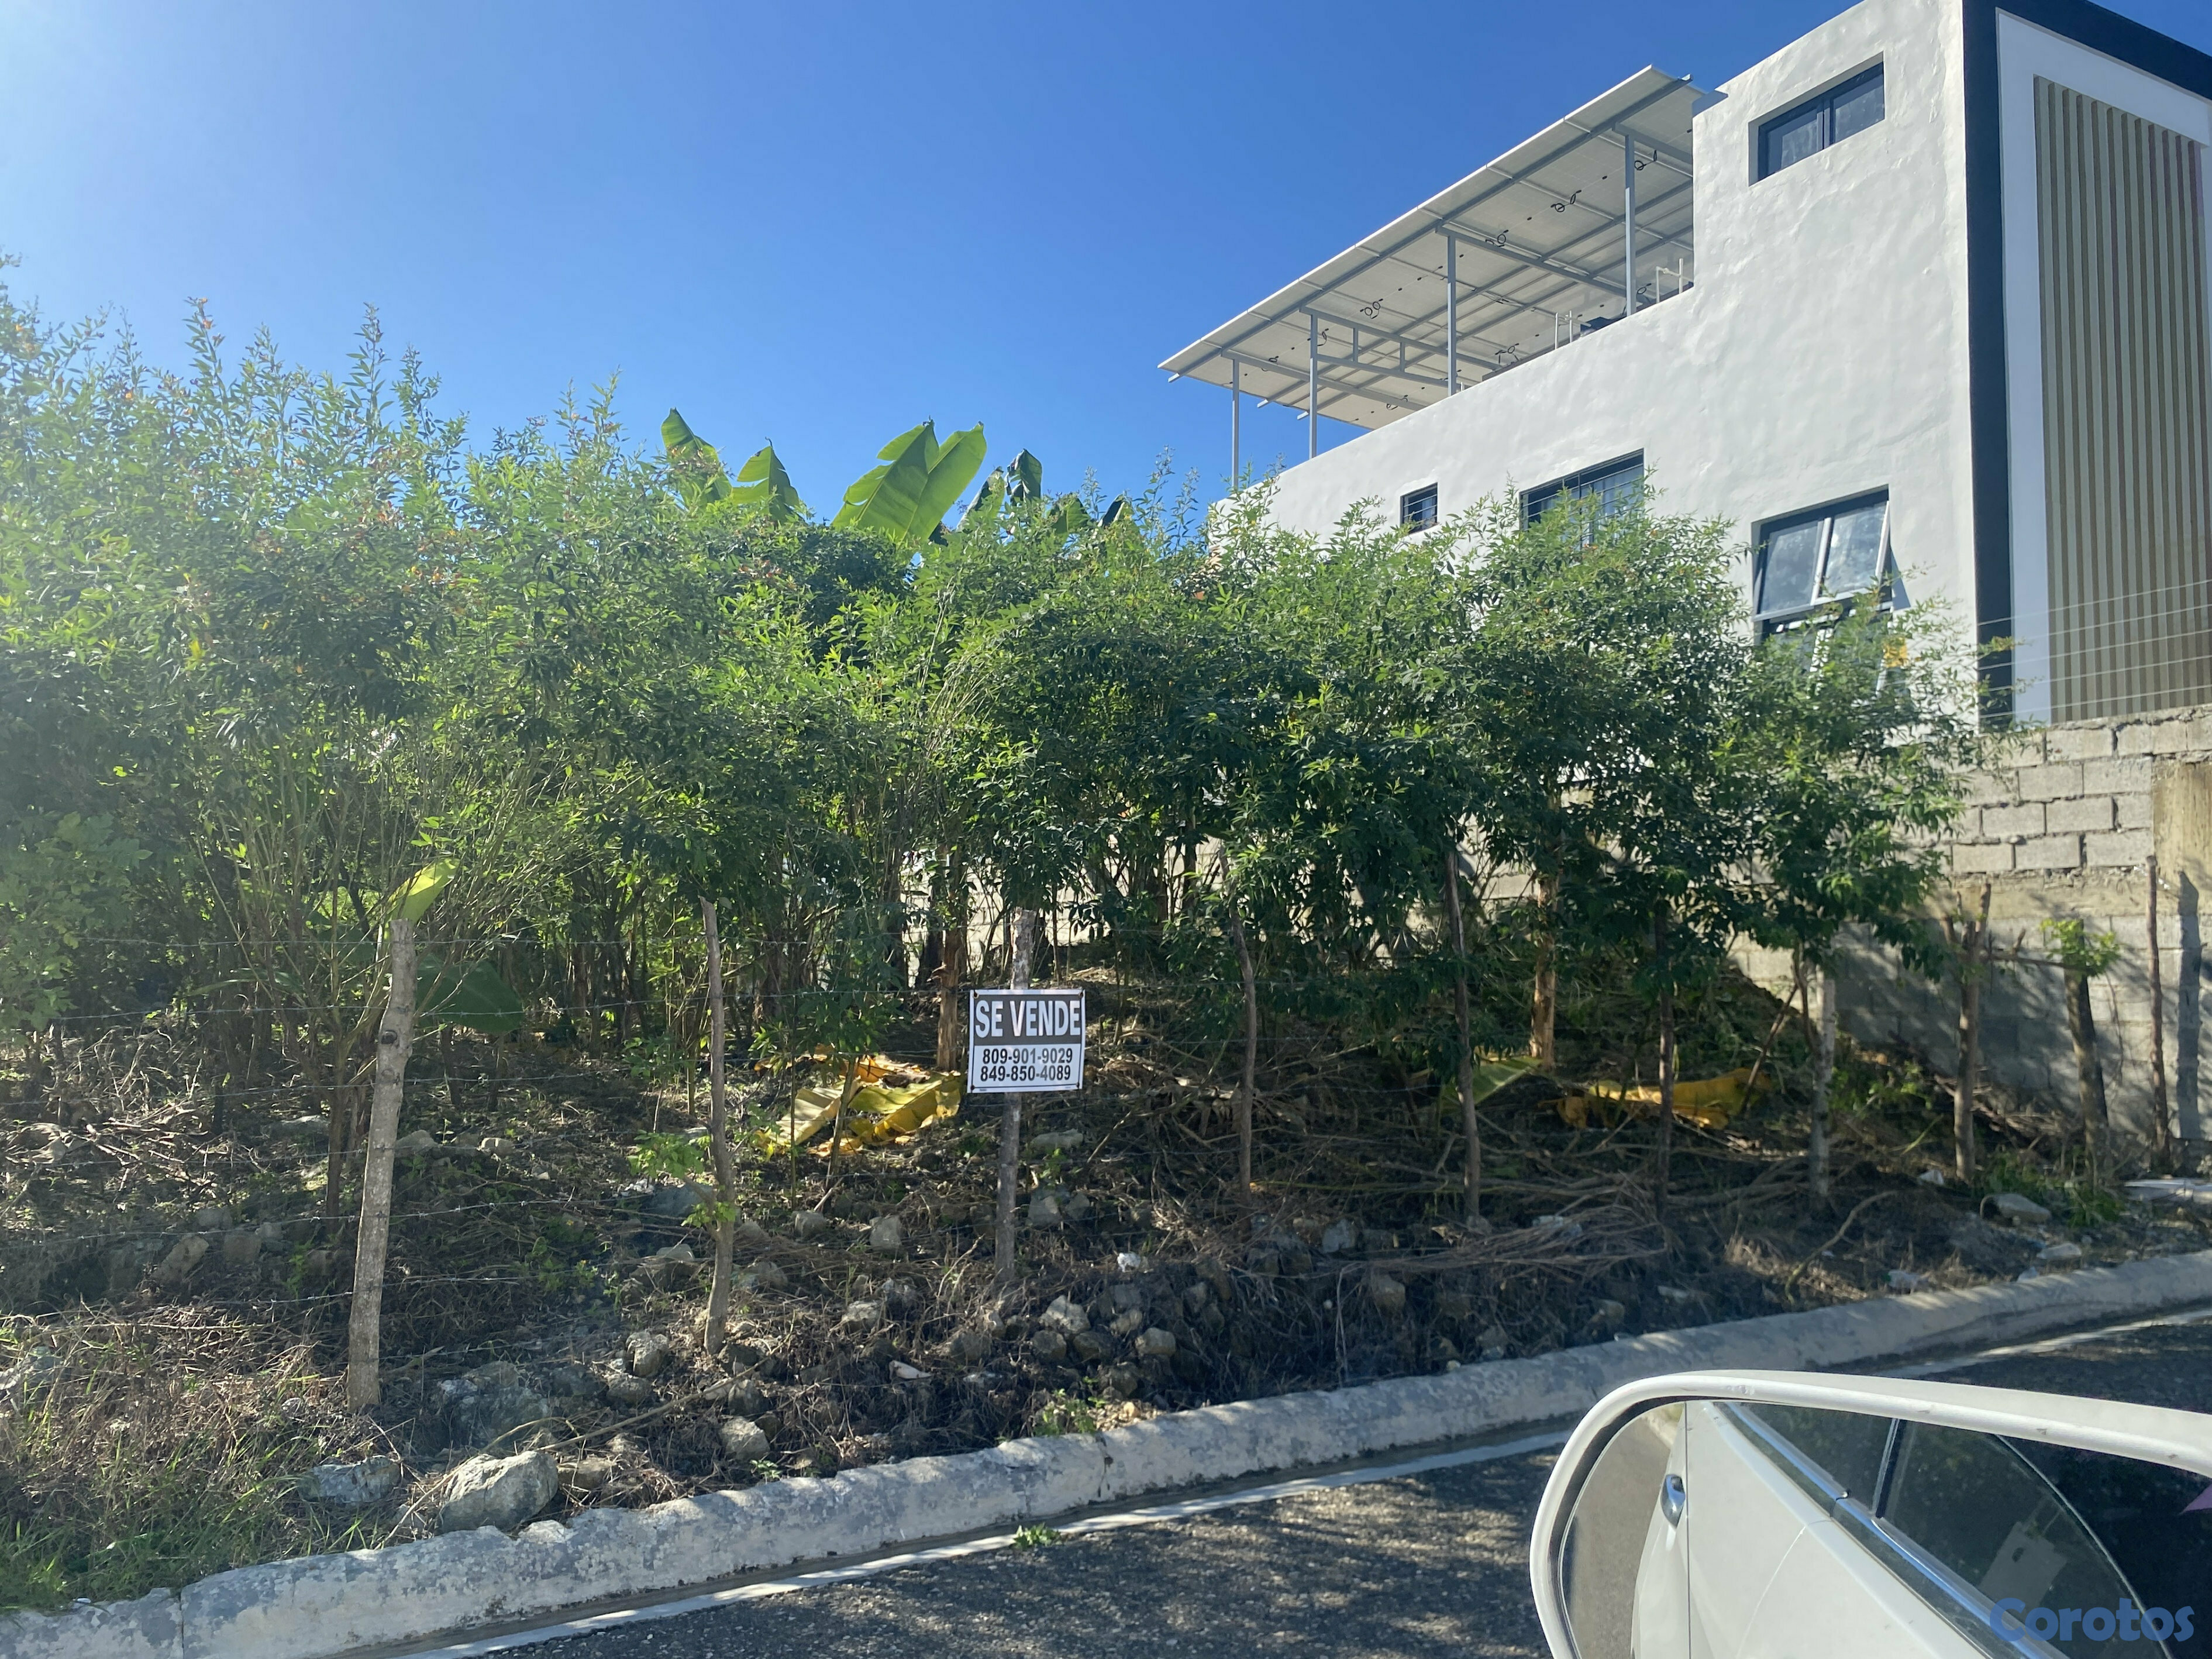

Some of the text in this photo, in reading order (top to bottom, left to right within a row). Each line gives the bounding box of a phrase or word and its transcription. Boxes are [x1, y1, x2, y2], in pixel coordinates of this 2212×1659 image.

[976, 1000, 1080, 1038] SE VENDE
[983, 1048, 1073, 1064] 809-901-9029
[980, 1065, 1071, 1082] 849-850-4089
